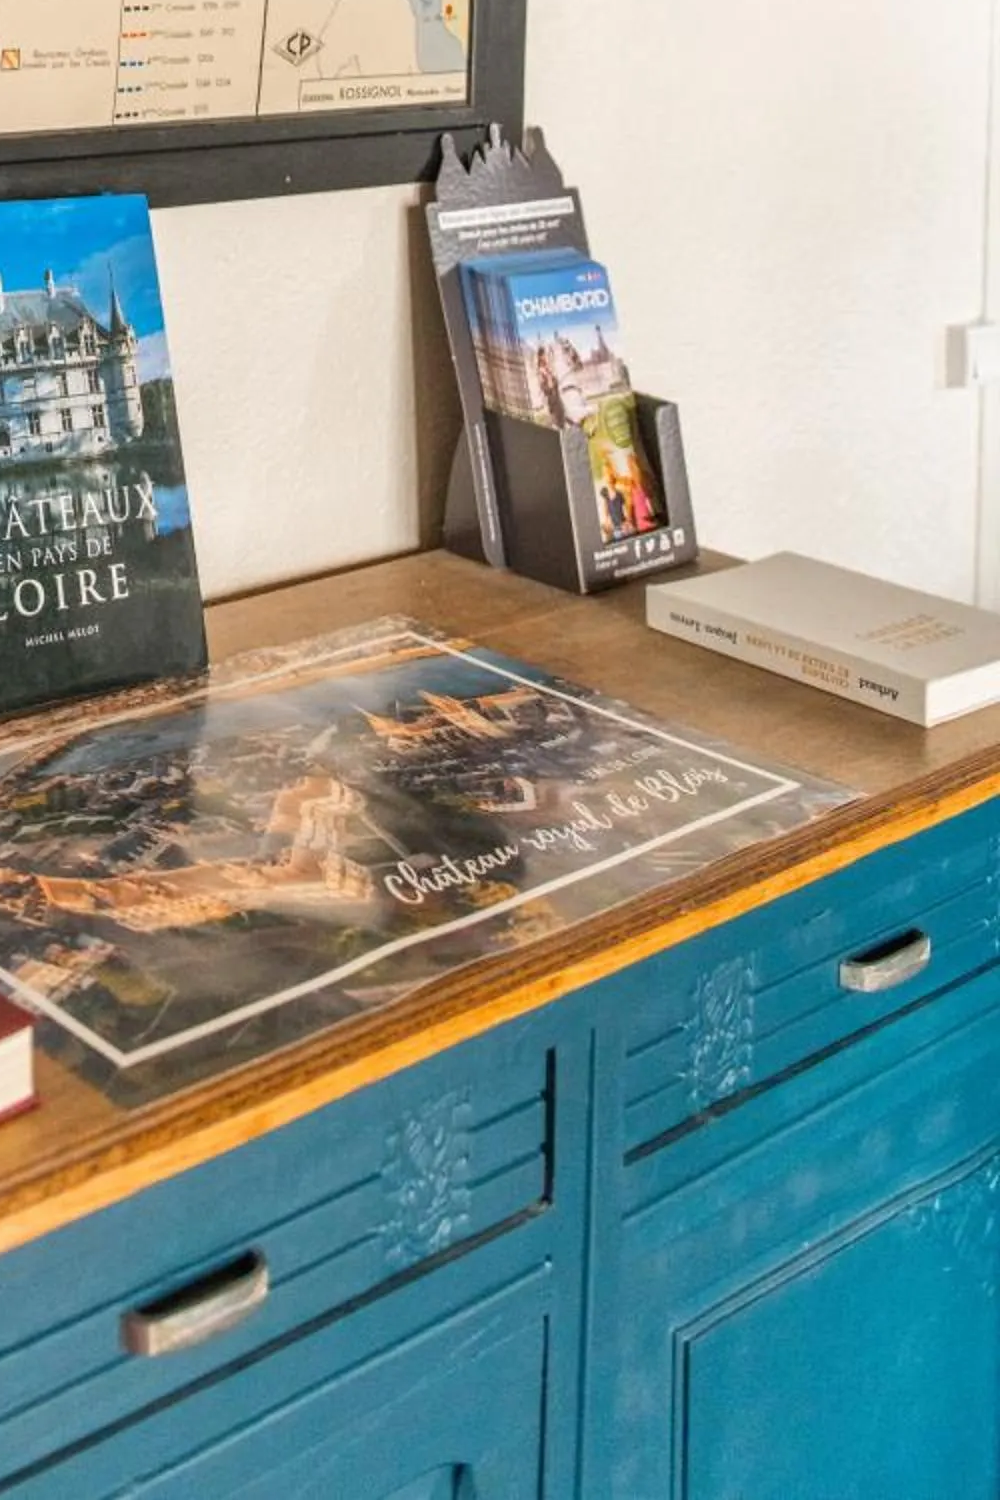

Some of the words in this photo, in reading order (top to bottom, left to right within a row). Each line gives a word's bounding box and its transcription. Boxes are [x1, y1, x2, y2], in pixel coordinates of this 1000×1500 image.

[339, 84, 402, 100] ROSSIGNOL
[521, 288, 609, 318] CHAMBORD
[31, 541, 78, 568] PAYS
[86, 535, 113, 556] DE
[25, 631, 65, 648] MICHEL
[384, 842, 520, 905] Château
[522, 800, 613, 853] royal
[609, 791, 649, 820] de
